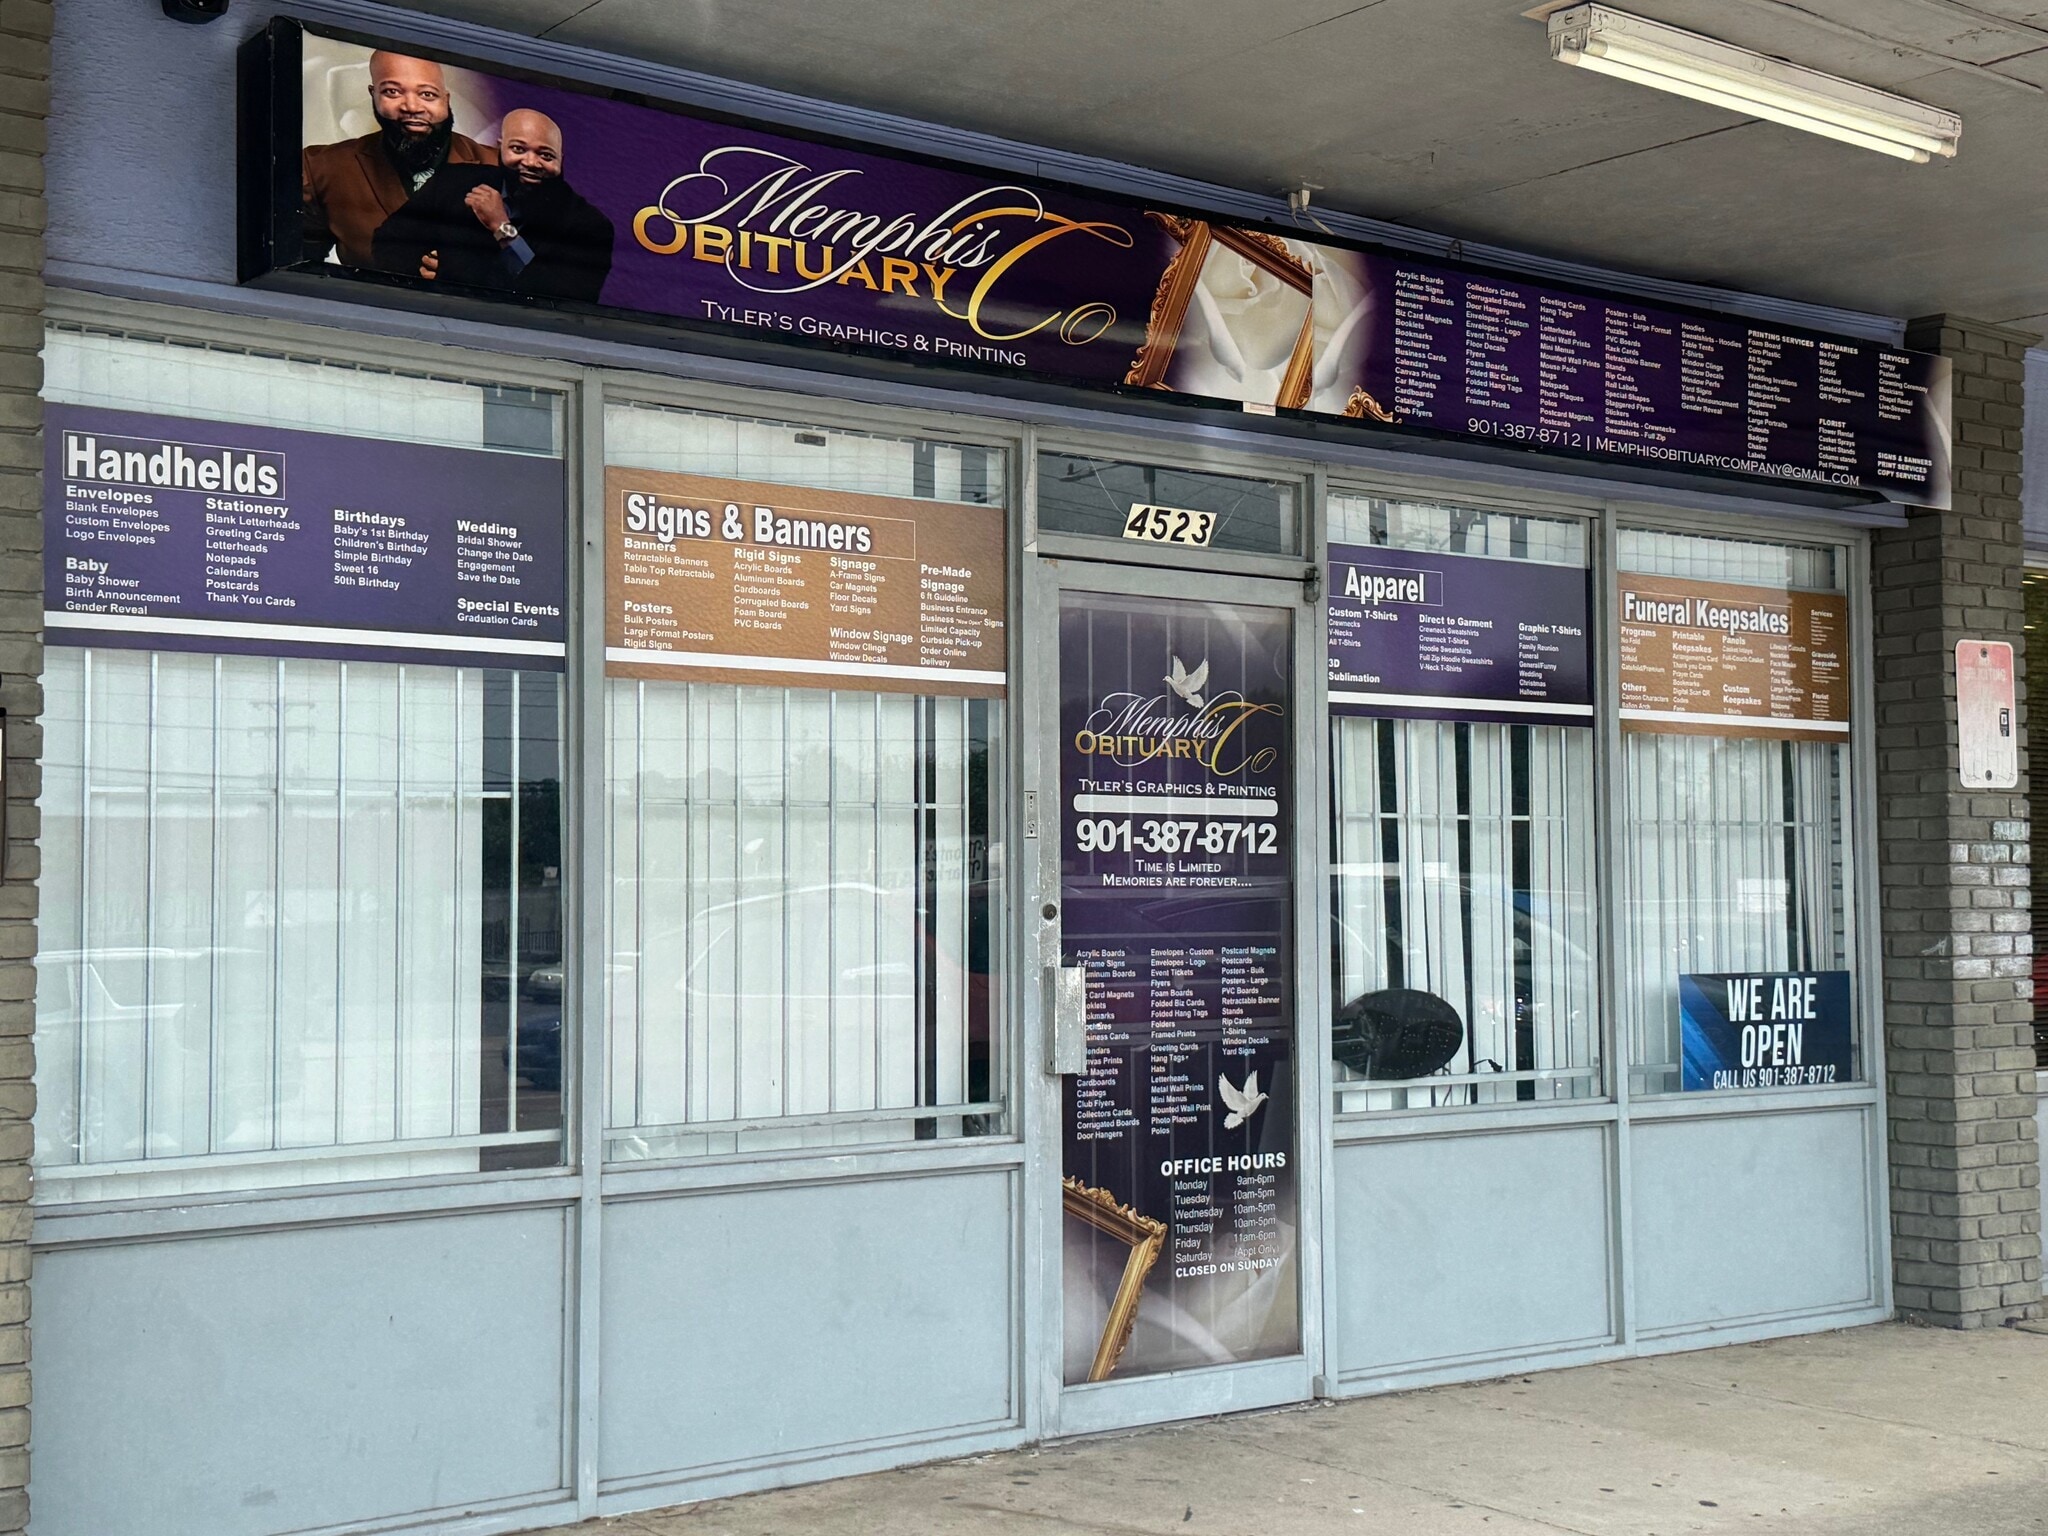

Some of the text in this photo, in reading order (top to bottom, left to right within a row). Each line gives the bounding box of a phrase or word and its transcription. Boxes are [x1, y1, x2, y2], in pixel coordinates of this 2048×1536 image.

[659, 146, 1044, 293] Memphis
[633, 205, 957, 301] OBITUARY
[1396, 270, 1444, 285] Acrylic Boards
[1396, 299, 1423, 310] Banners
[701, 300, 1026, 366] TYLER'S GRAPHICS & PRINTING
[1748, 330, 1814, 347] PRINTING SERVICES
[1395, 348, 1447, 362] Business Cards
[1466, 350, 1485, 359] Flyers
[1681, 349, 1704, 359] T-Shirts
[1819, 342, 1858, 354] OBITUARIES
[1879, 353, 1909, 364] SERVICES
[1395, 406, 1432, 417] Club Flyers
[1819, 419, 1846, 428] FLORIST
[1467, 418, 1582, 447] 901-387-8712
[1596, 437, 1859, 487] MEMPHISOBITUARYCOMPANY@GMAIL.COM
[67, 435, 278, 495] Handhelds
[66, 485, 153, 504] Envelopes
[66, 502, 159, 518] Blank Envelopes
[206, 498, 288, 518] Stationery
[66, 515, 170, 532] Custom Envelopes
[334, 510, 406, 527] Birthdays
[627, 494, 871, 552] Signs & Banners
[1128, 507, 1210, 543] 4523
[457, 520, 517, 538] Wedding
[206, 540, 268, 553] Letterheads
[457, 535, 522, 549] Bridal Shower
[625, 538, 676, 552] Banners
[206, 553, 256, 566] Notepads
[334, 550, 412, 566] Simple Birthday
[734, 548, 801, 564] Rigid Signs
[66, 557, 108, 574] Baby
[334, 563, 379, 574] Sweet 16
[734, 562, 792, 574] Acrylic Boards
[830, 557, 876, 572] Signage
[921, 564, 972, 578] Pre-Made
[206, 566, 259, 578] Calendars
[457, 572, 520, 585] Save the Date
[206, 579, 259, 591] Postcards
[334, 576, 400, 591] 50th Birthday
[734, 585, 780, 596] Cardboards
[845, 583, 877, 593] Magnets
[921, 579, 964, 593] Signage
[1344, 567, 1424, 605] Apparel
[206, 592, 296, 607] Thank You Cards
[830, 593, 877, 604] Floor Decals
[457, 598, 560, 616] Special Events
[625, 601, 673, 614] Posters
[830, 604, 871, 615] Yard Signs
[921, 603, 987, 615] Business Entrance
[1329, 607, 1398, 621] Custom T-Shirts
[1625, 592, 1690, 625] Funeral
[1696, 599, 1789, 635] Keepsakes
[457, 613, 538, 626] Graduation Cards
[625, 615, 678, 626] Bulk Posters
[734, 619, 782, 630] PVC Boards
[1329, 619, 1360, 627] Crewnecks
[1419, 614, 1492, 628] Direct to Garment
[625, 627, 714, 641] Large Format Posters
[830, 628, 913, 644] Window Signage
[1329, 628, 1353, 637] V-Necks
[1519, 623, 1581, 636] Graphic T-Shirts
[1621, 627, 1656, 638] Programs
[1723, 636, 1745, 645] Panels
[830, 652, 887, 663] Window Decals
[921, 657, 950, 668] Delivery
[1329, 659, 1340, 668] 3D
[1329, 672, 1380, 683] Sublimation
[1622, 683, 1647, 693] Others
[1723, 685, 1749, 694] Custom
[1723, 696, 1762, 706] Keepsakes
[1086, 690, 1244, 767] Memphis
[1075, 729, 1207, 759] OBITUARY
[1079, 779, 1276, 796] TYLER'S GRAPHICS & PRINTING
[1076, 819, 1277, 854] 901-387-8712
[1135, 860, 1221, 872] TIME IS LIMITED
[1103, 874, 1162, 886] MEMORIES
[1166, 878, 1187, 886] ARE
[1077, 950, 1100, 959] Acrylic
[1222, 957, 1252, 965] Postcards
[1171, 989, 1193, 997] Boards
[1222, 987, 1235, 995] PVC
[1727, 978, 1817, 1022] WE ARE
[1741, 1023, 1802, 1068] OPEN
[1714, 1065, 1835, 1089] CALL US 901-387-8712
[1077, 1089, 1106, 1098] Catalogs
[1077, 1110, 1110, 1119] Collectors
[1161, 1152, 1286, 1176] OFFICE HOURS
[1175, 1174, 1275, 1190] Monday 9am-6pm
[1175, 1188, 1275, 1205] Tuesday 10am-5pm
[1175, 1203, 1275, 1219] Wednesday 10am-5pm
[1176, 1217, 1275, 1234] Thursday 10am-5pm
[1176, 1231, 1275, 1249] Friday 11am-6pm
[1176, 1251, 1212, 1263] Saturday
[1176, 1257, 1279, 1278] CLOSED ON SUNDAY
